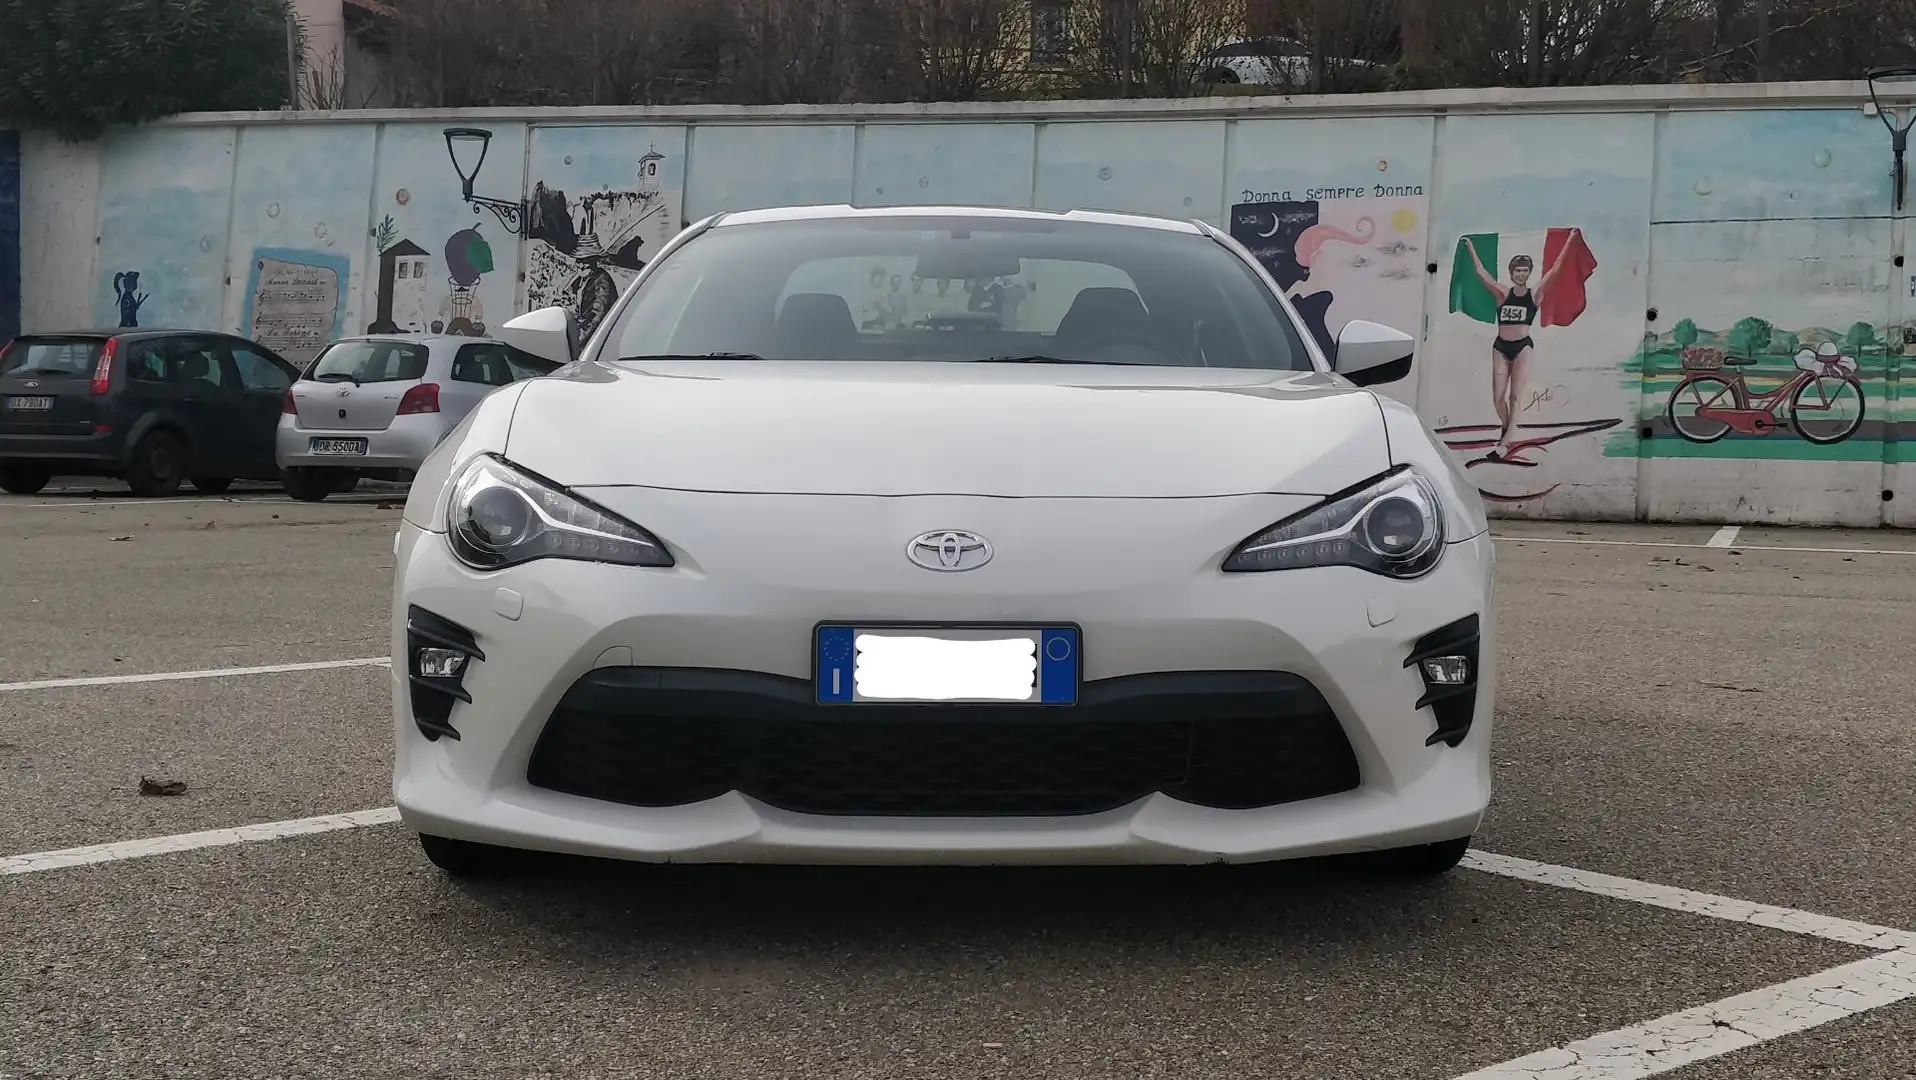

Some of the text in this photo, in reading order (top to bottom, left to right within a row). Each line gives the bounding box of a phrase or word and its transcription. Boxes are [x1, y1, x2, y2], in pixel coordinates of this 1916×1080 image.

[1241, 183, 1423, 203] Donna sempre Donna
[1502, 307, 1523, 320] 3454
